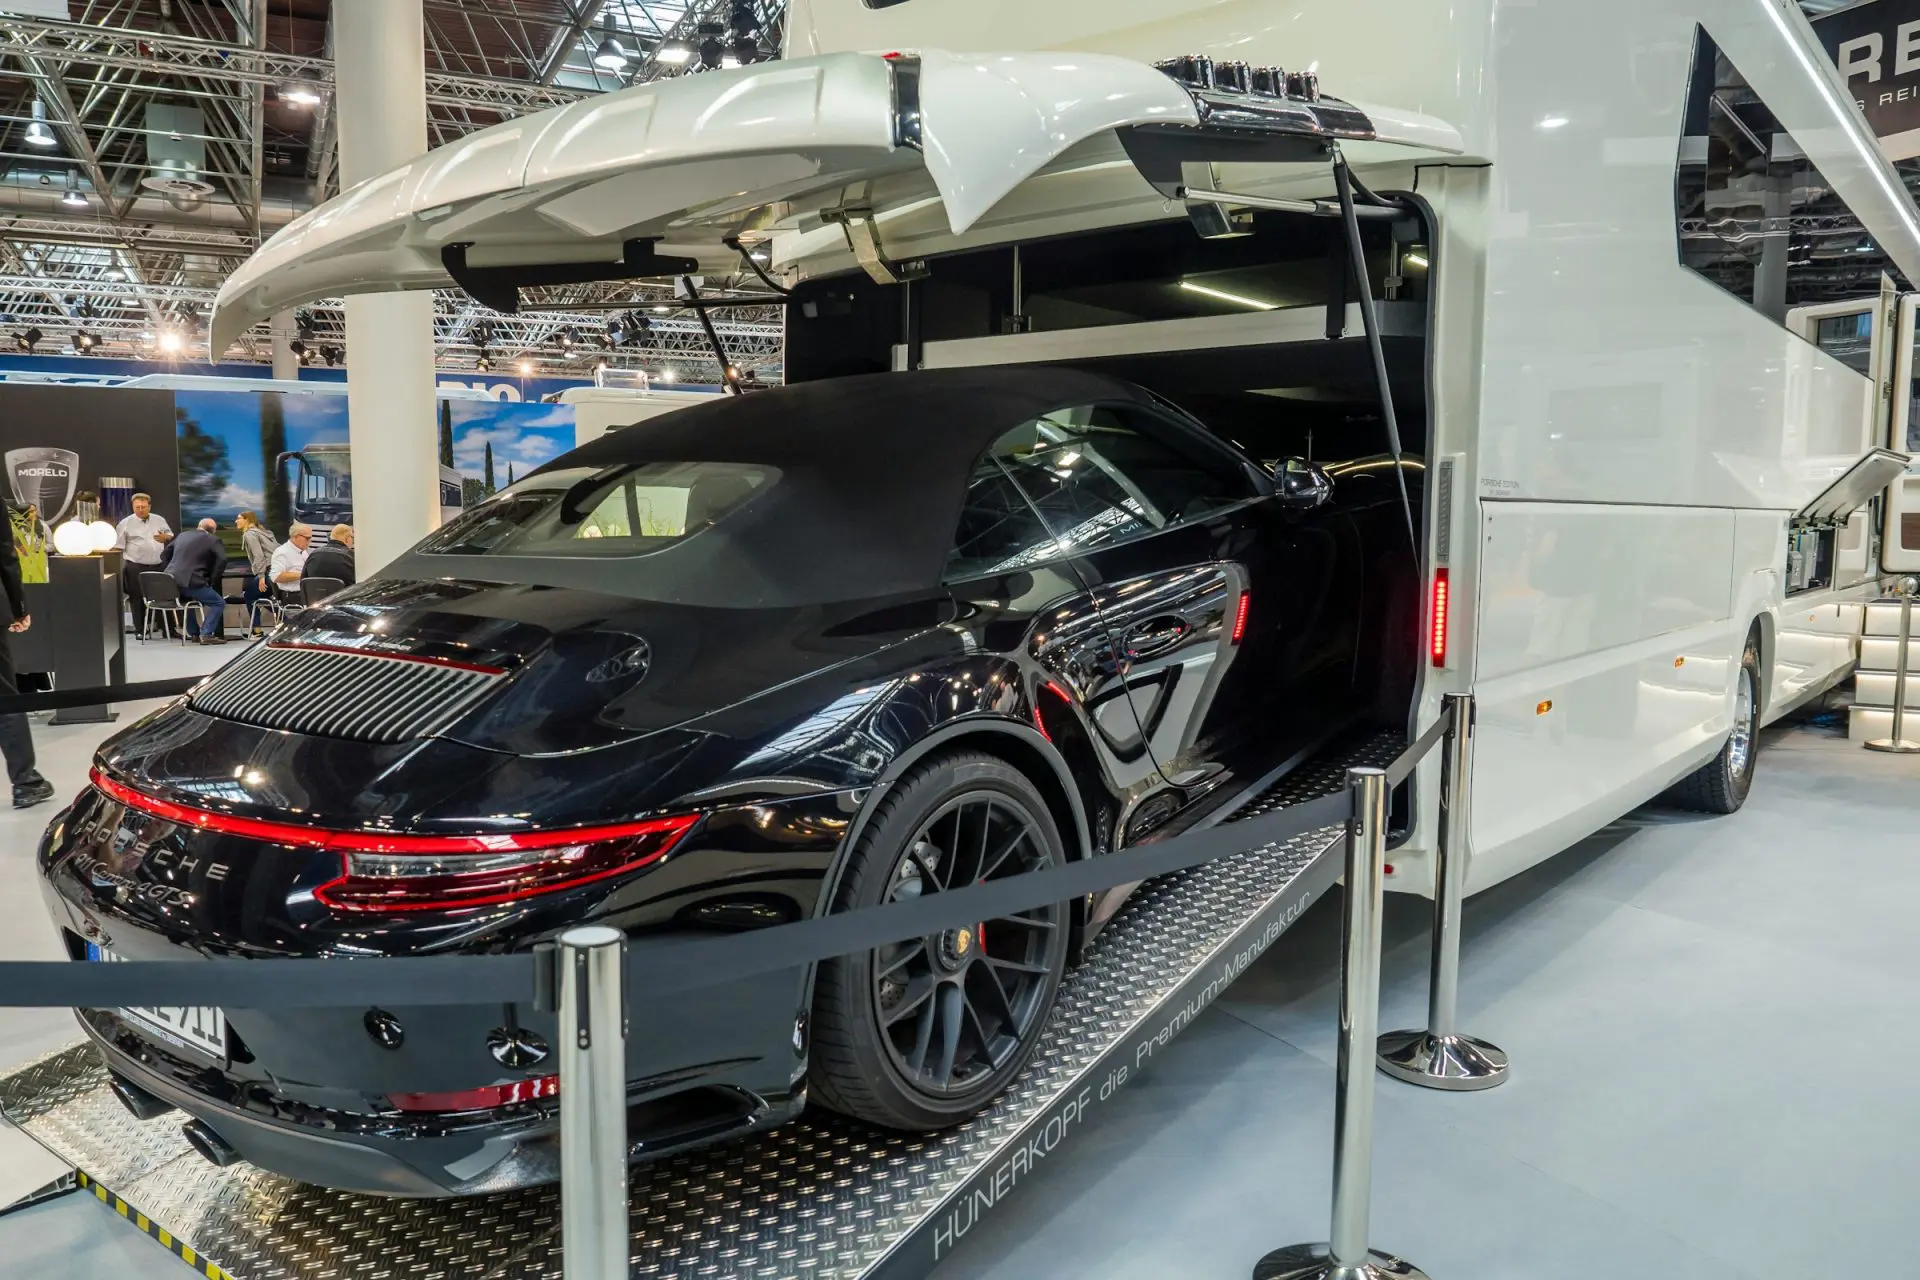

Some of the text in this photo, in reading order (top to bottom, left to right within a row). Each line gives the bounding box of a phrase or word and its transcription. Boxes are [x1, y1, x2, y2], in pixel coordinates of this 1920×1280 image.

[1879, 86, 1917, 106] REI
[18, 467, 68, 477] MORELO
[84, 820, 231, 881] PORSCHE
[934, 892, 1310, 1261] HÜNERKOPF die Premium-Manufaktur
